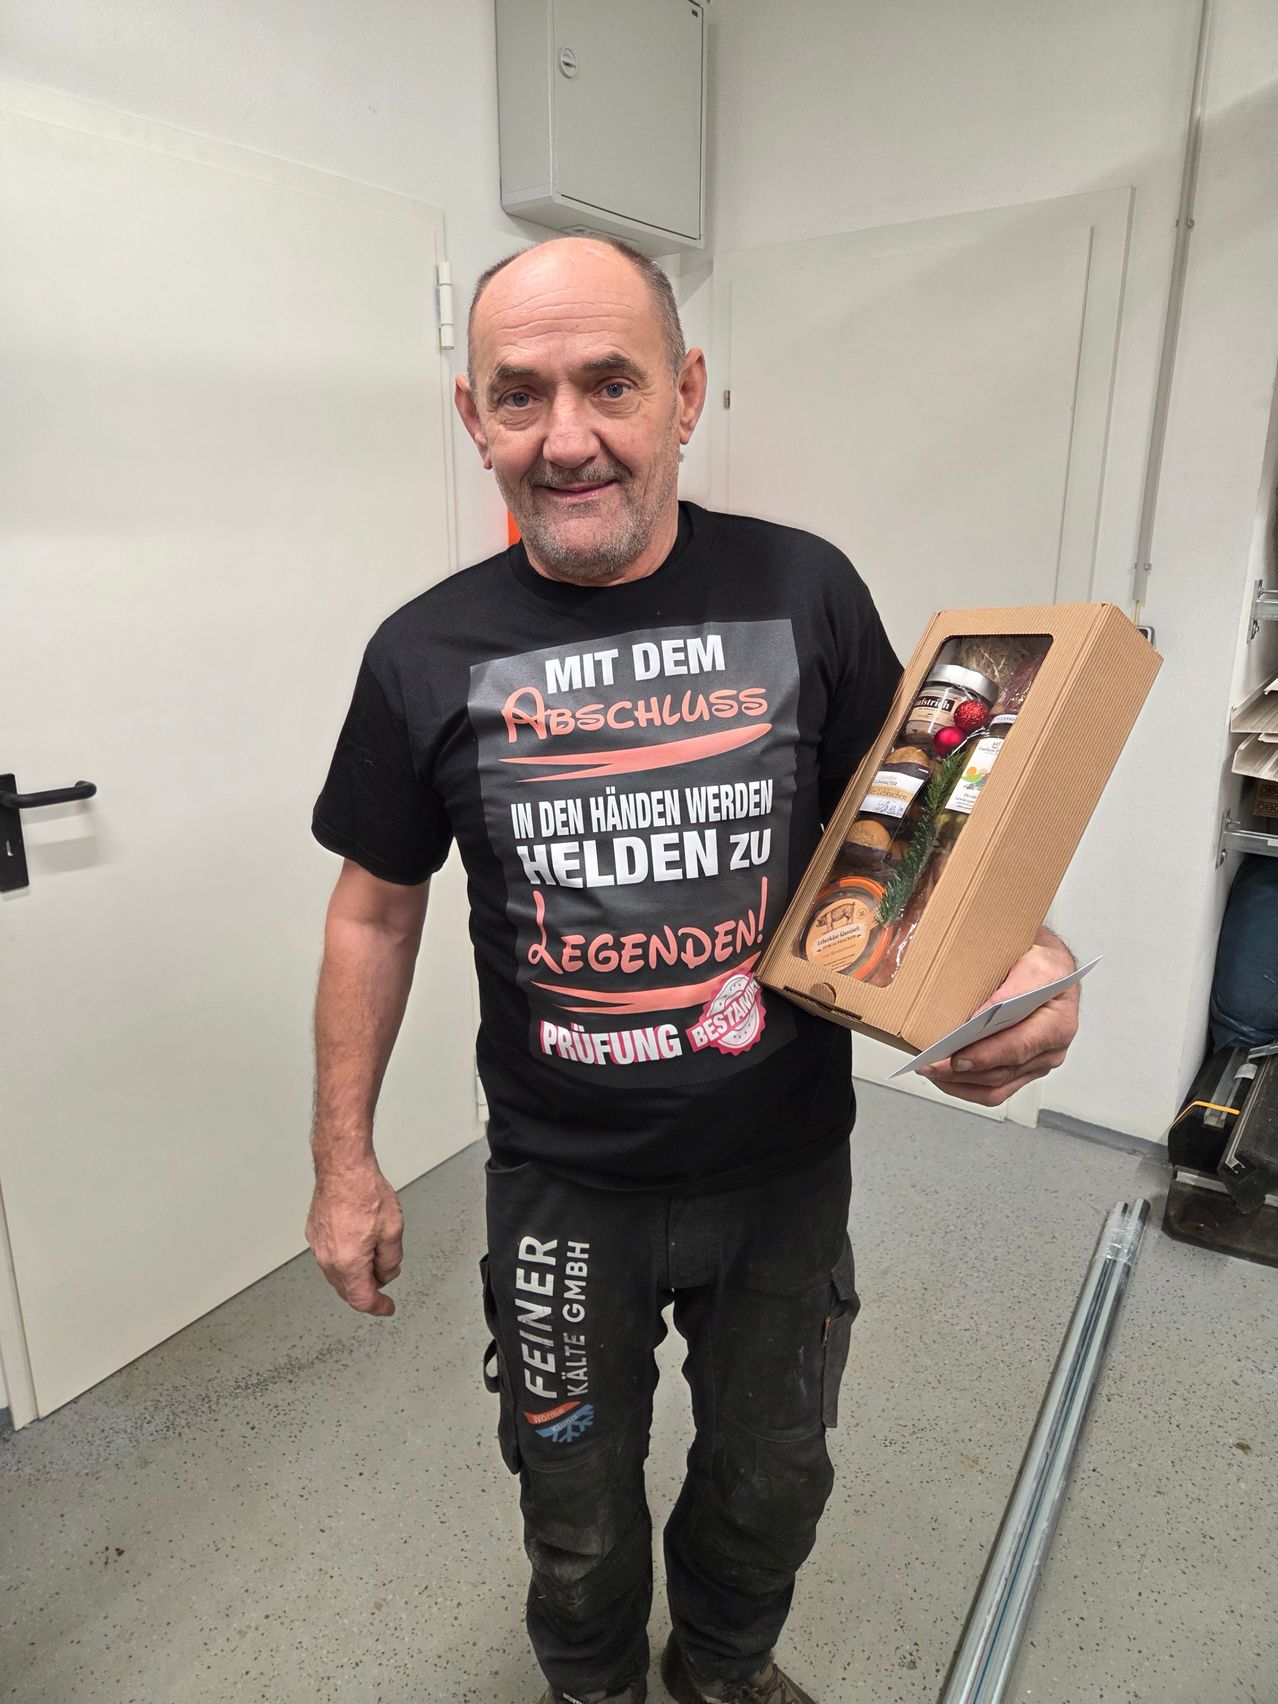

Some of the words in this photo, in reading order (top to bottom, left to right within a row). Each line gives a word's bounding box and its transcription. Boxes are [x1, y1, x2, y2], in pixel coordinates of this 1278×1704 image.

[545, 649, 619, 694] MIT
[631, 634, 726, 681] DEM
[511, 803, 534, 839] IN
[539, 799, 583, 838] DEN
[590, 786, 681, 832] HÄNDEN
[685, 779, 774, 825] WERDEN
[516, 829, 719, 888] HELDEN
[729, 828, 771, 871] ZU
[541, 1020, 683, 1065] PRÜFUNG
[562, 1240, 590, 1323] GMBH
[515, 1235, 558, 1399] FEINER
[561, 1332, 589, 1397] KÄLTE
